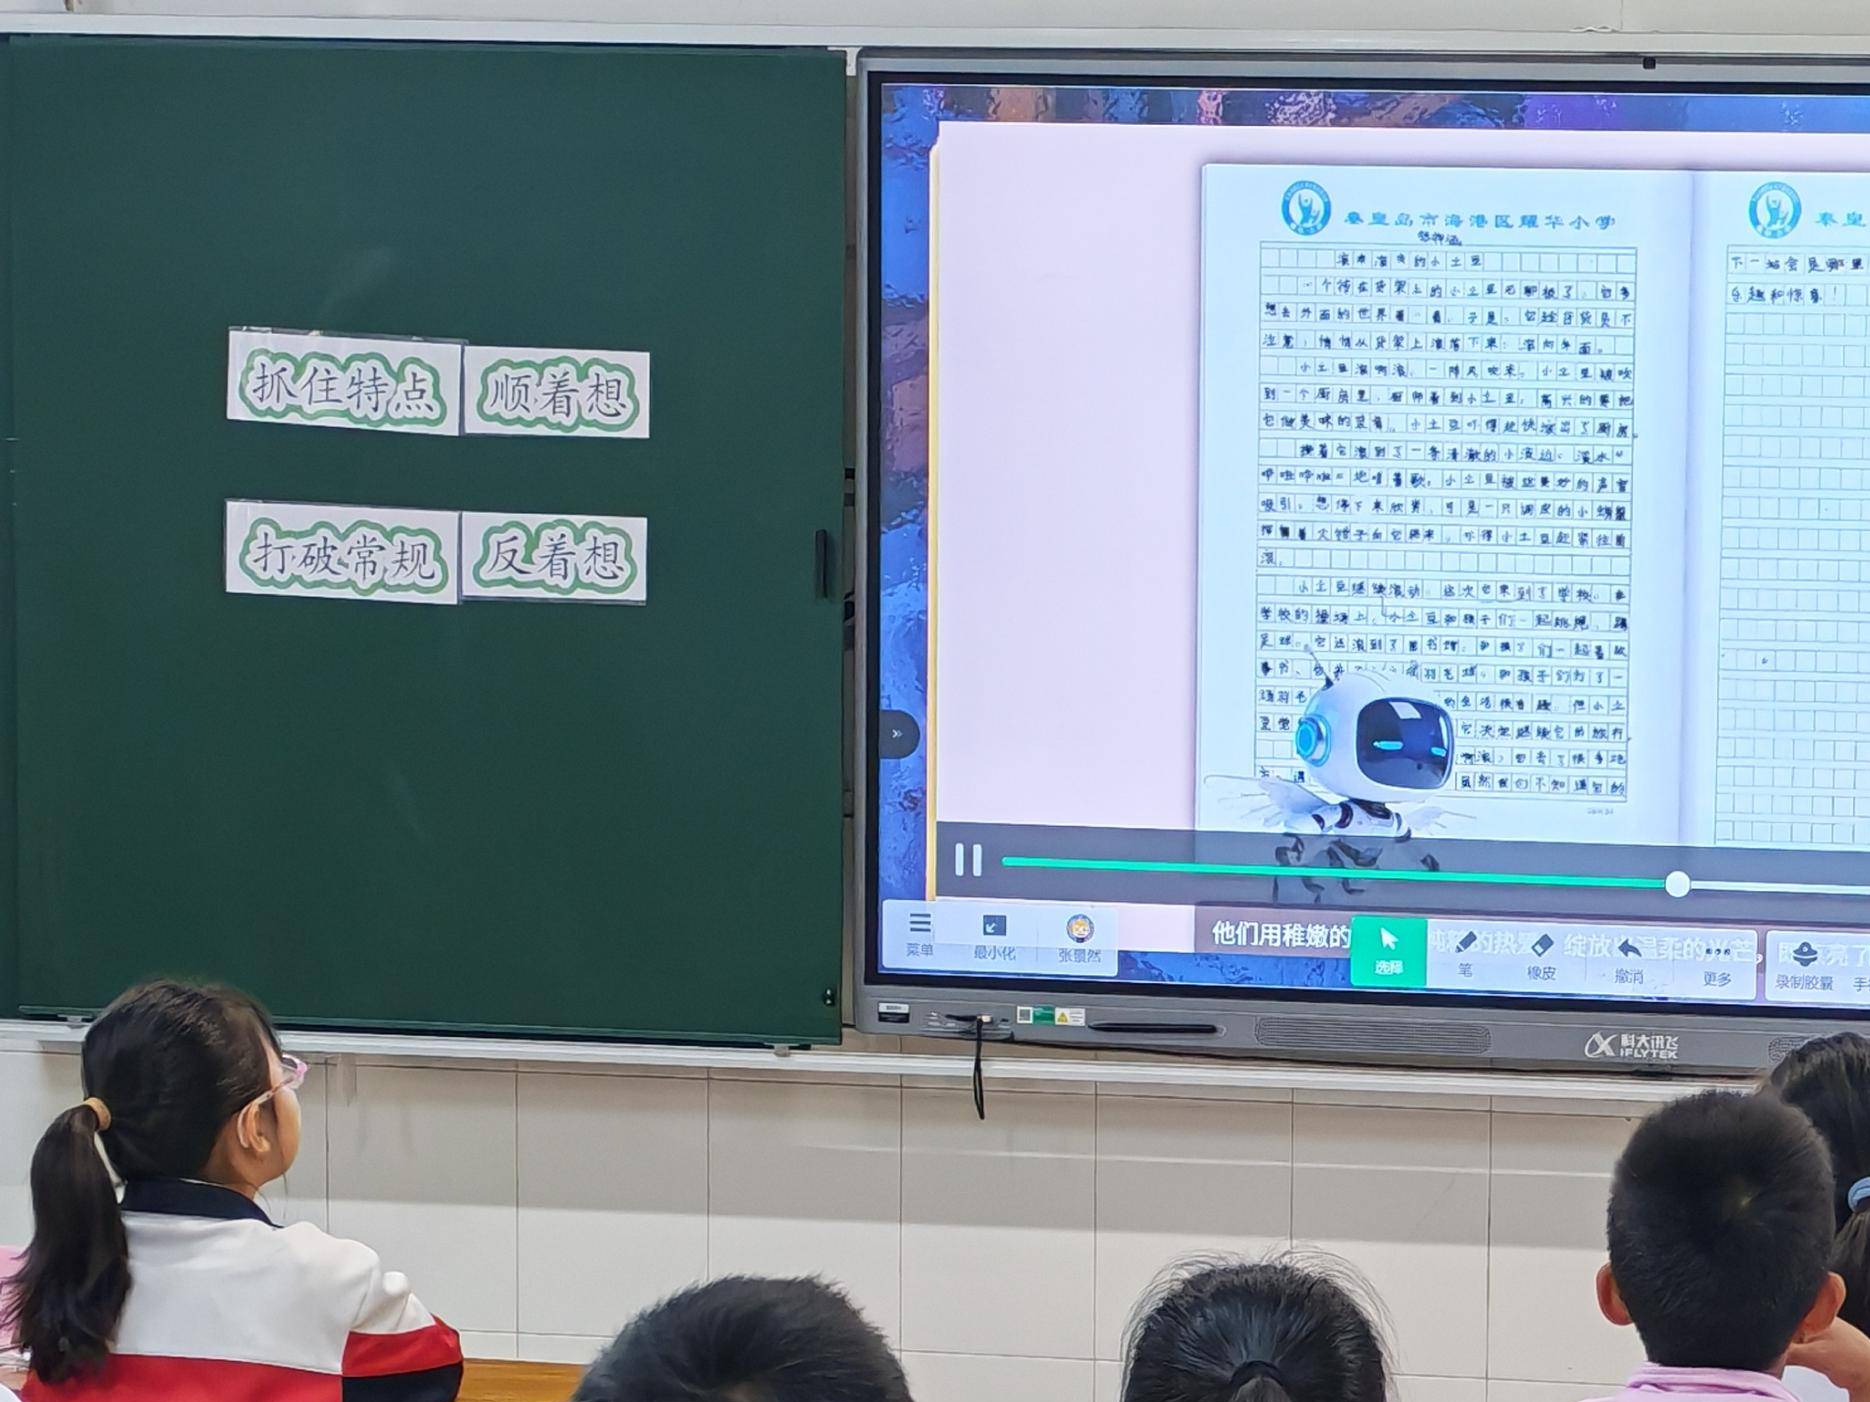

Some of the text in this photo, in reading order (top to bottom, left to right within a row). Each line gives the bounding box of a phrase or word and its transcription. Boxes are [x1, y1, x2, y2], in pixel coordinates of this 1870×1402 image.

[251, 362, 627, 418] 抓住特点 顺着想
[251, 531, 626, 581] 打破常规 反着想
[1211, 919, 1351, 949] 他们用稚嫩的
[905, 942, 935, 958] 菜单
[973, 944, 1017, 962] 最小化
[1374, 959, 1404, 977] 选择
[1457, 962, 1474, 978] 笔
[1527, 965, 1557, 981] 橡皮
[1703, 971, 1732, 987] 更多
[1775, 974, 1834, 993] 录制胶囊
[1620, 1033, 1679, 1049] 科大讯飞
